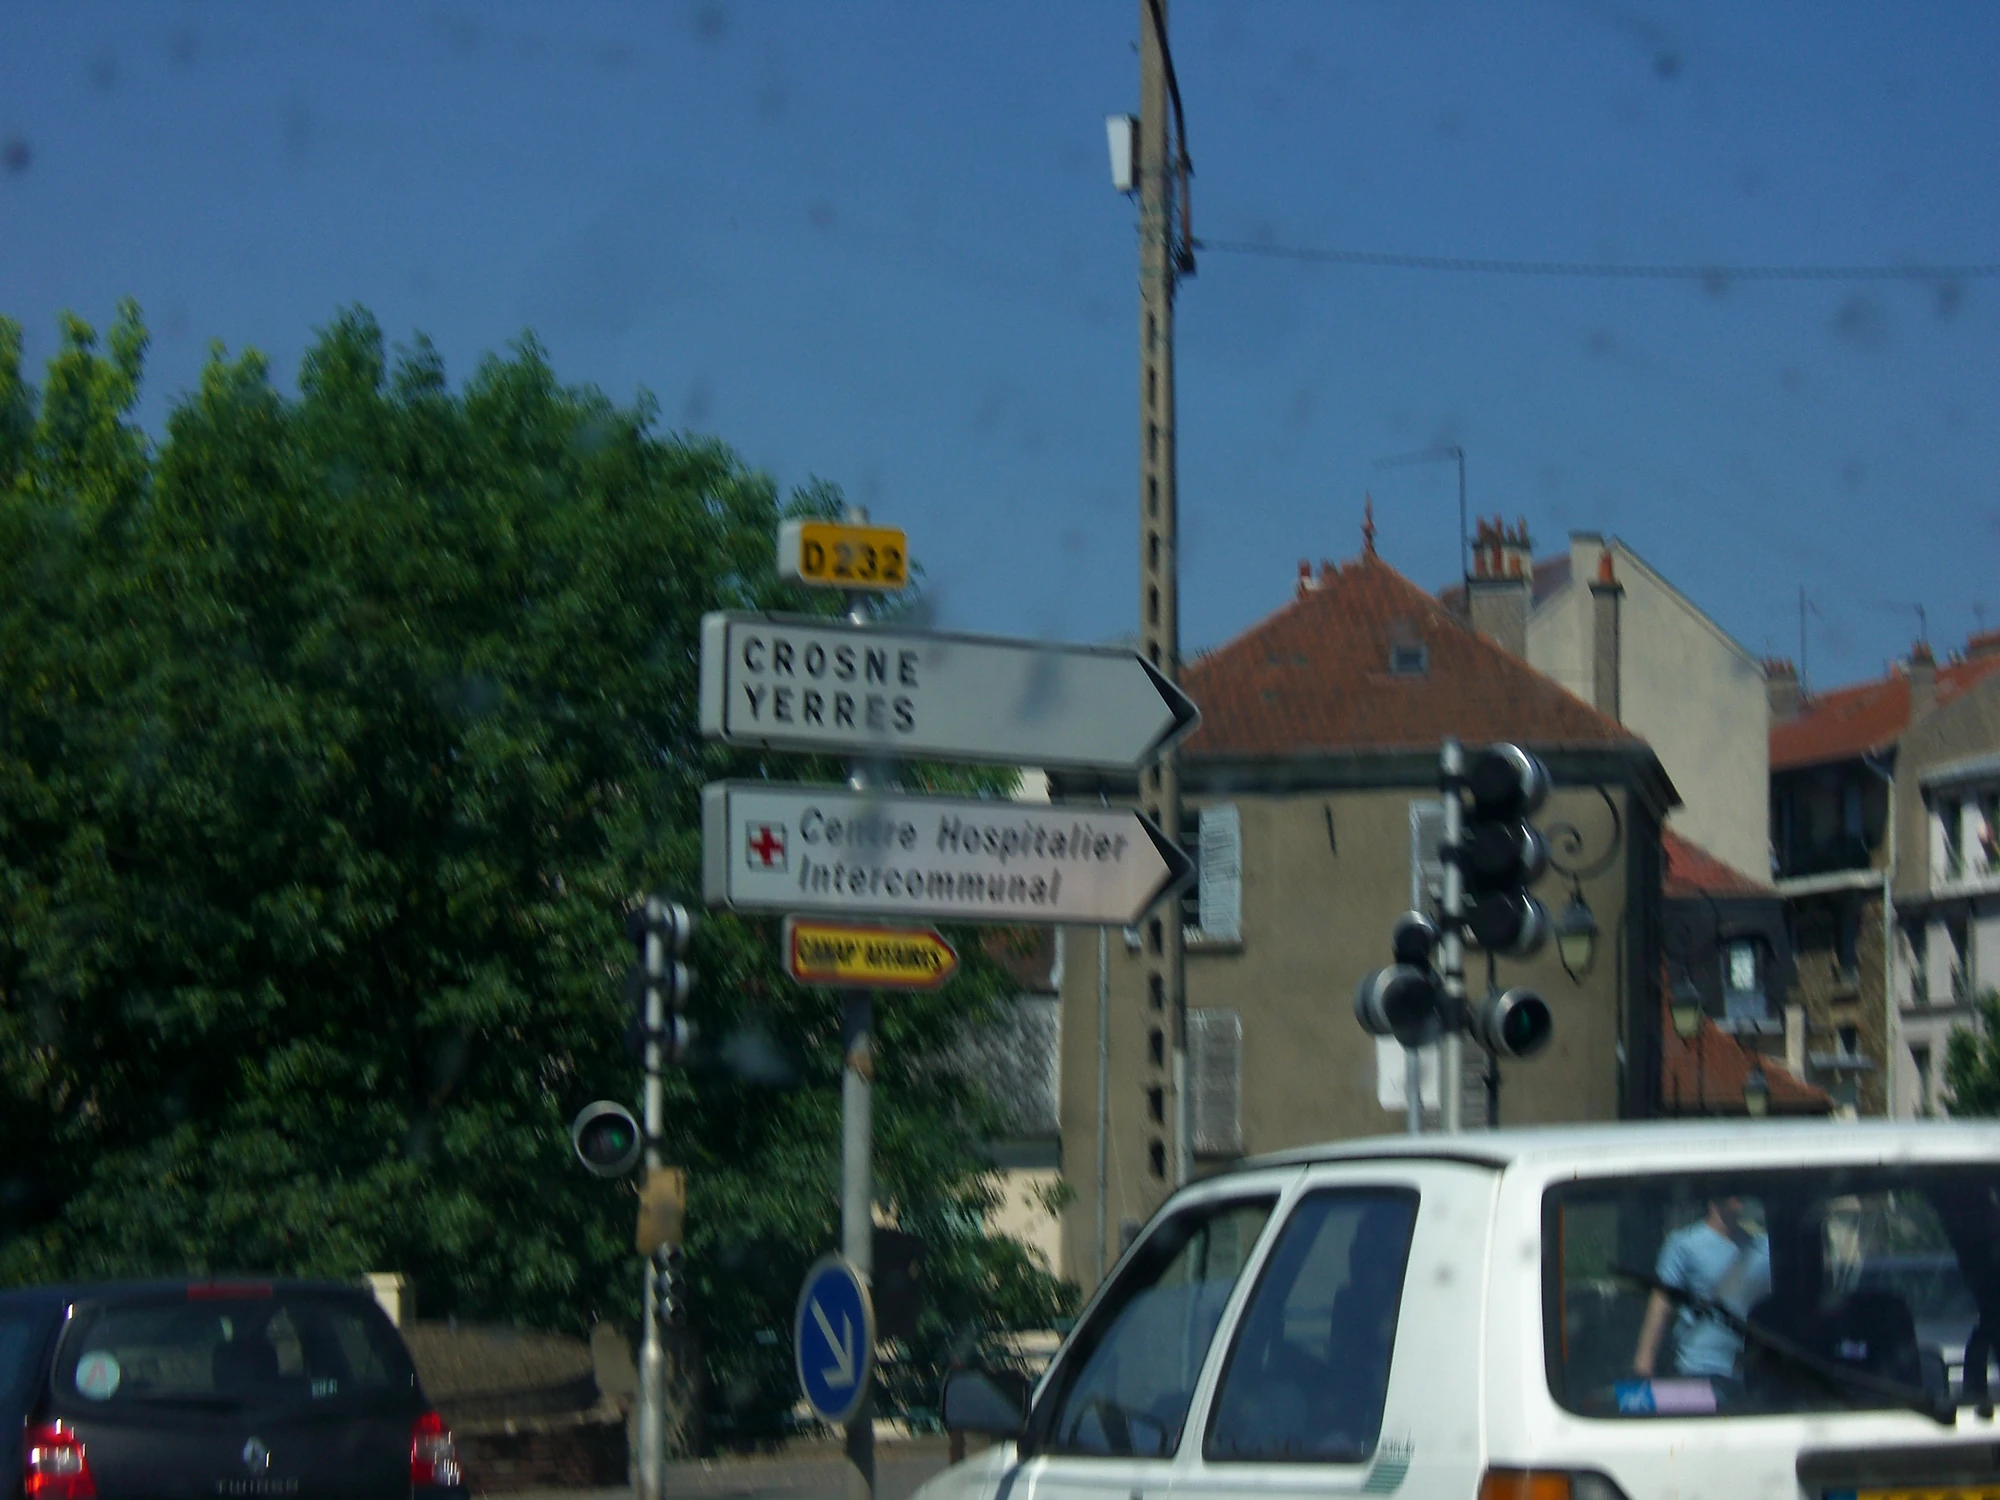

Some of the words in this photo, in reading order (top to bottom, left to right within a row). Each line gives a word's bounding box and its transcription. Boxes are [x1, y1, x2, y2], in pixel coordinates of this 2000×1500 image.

[742, 634, 919, 688] CROSNE
[742, 680, 916, 733] YERRES
[936, 813, 1129, 866] Hospitalier
[799, 852, 1063, 905] Intercommunal
